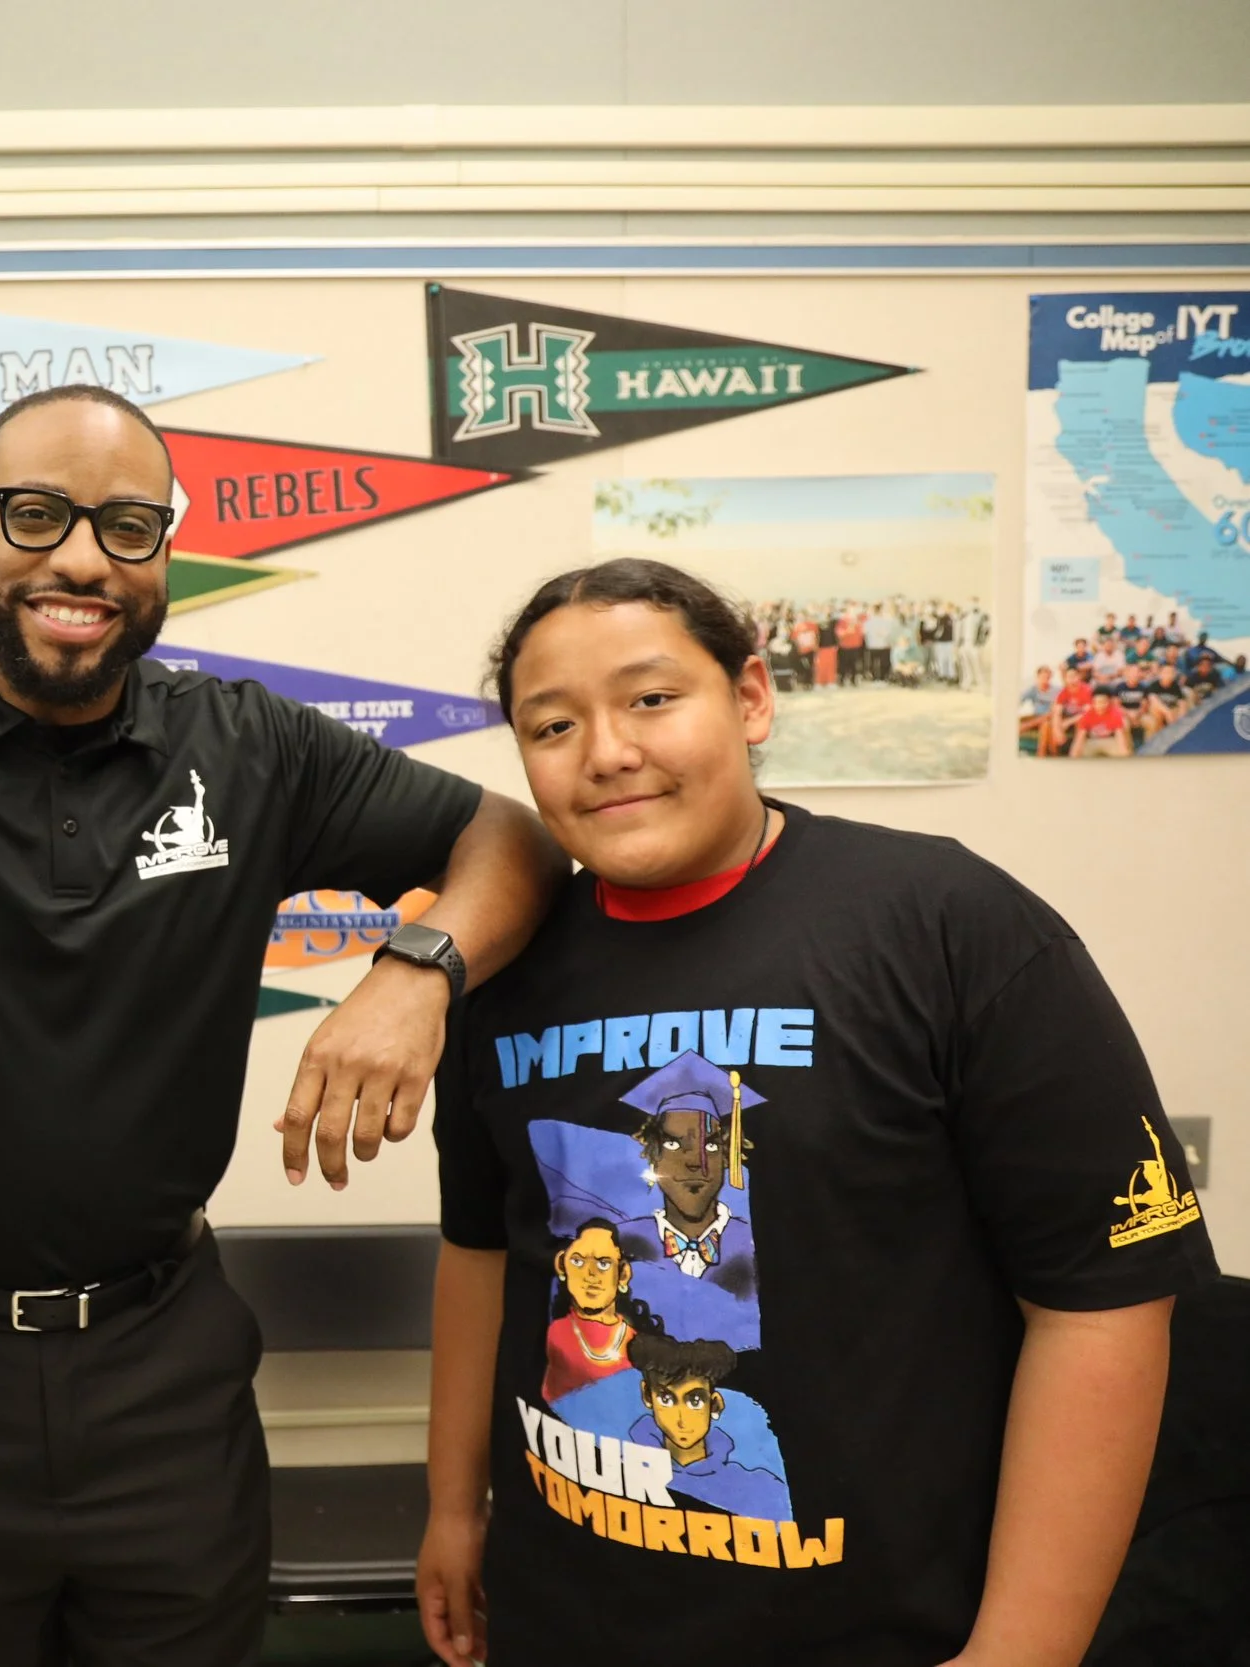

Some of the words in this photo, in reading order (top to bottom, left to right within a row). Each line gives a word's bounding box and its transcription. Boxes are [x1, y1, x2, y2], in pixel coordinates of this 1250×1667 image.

[1065, 304, 1155, 334] College
[1101, 328, 1157, 357] Map
[1155, 324, 1176, 345] of
[1176, 304, 1239, 341] IYT
[215, 467, 380, 523] REBELS
[352, 701, 414, 719] STATE
[135, 838, 228, 870] IMPROVE
[495, 1007, 815, 1089] IMPROVE
[516, 1396, 676, 1508] YOUR
[525, 1449, 845, 1569] TOMORROW
